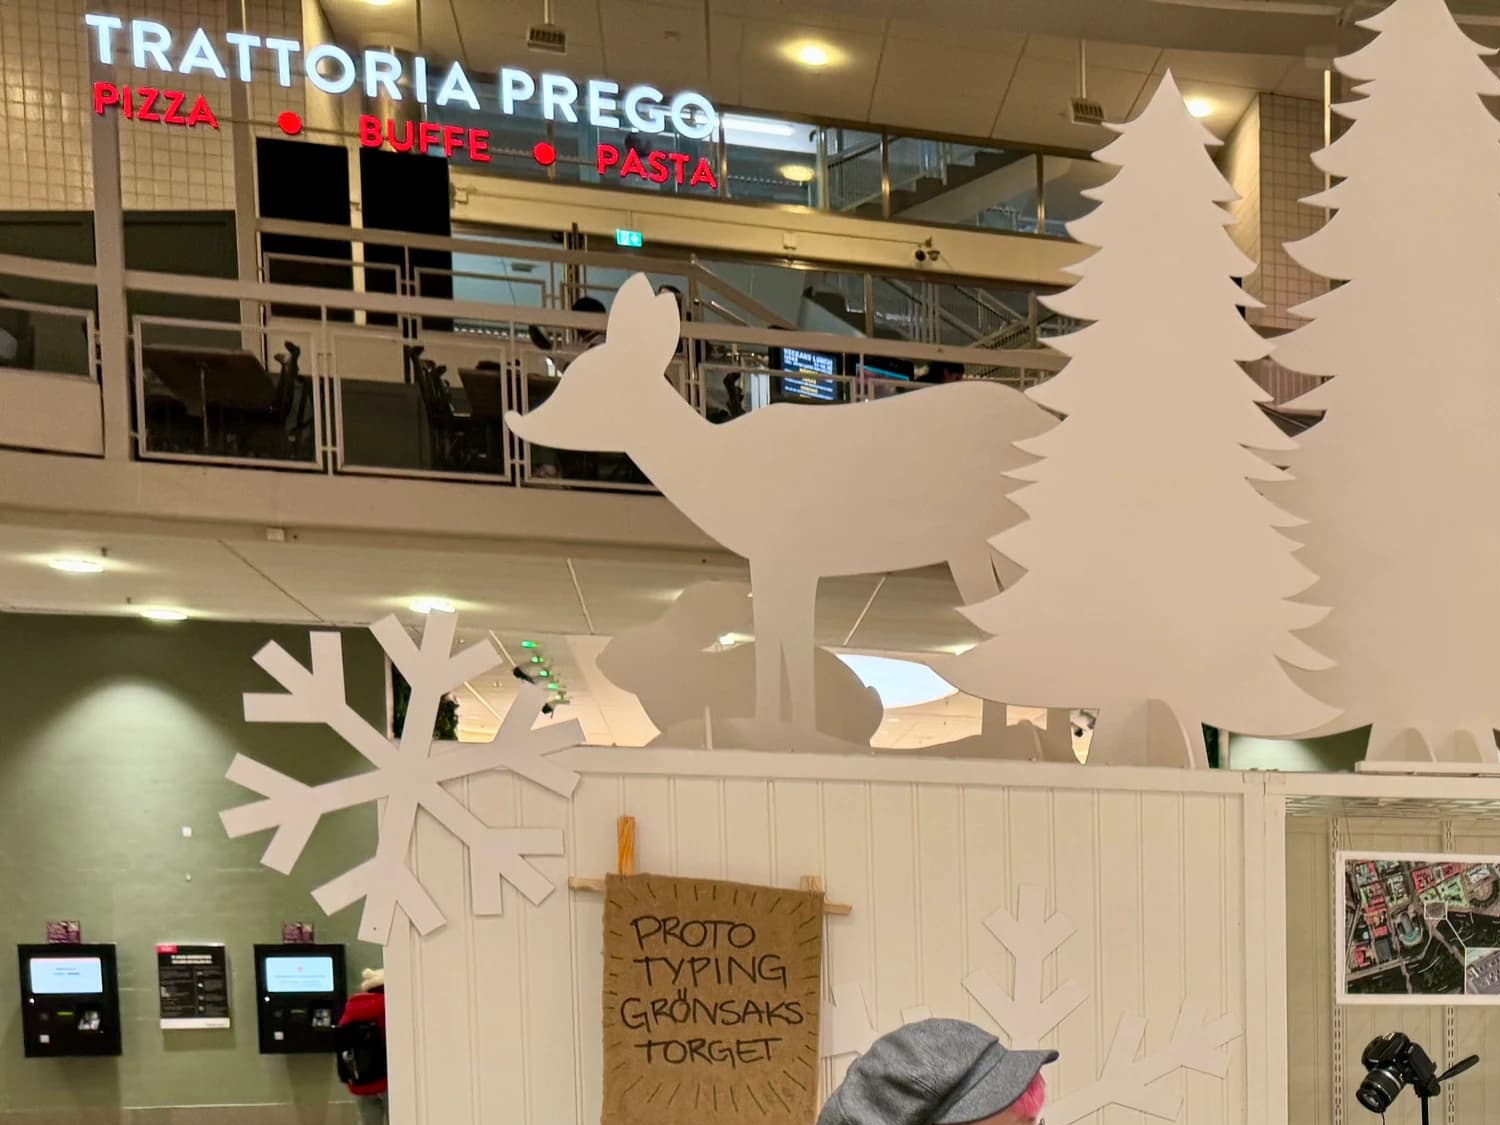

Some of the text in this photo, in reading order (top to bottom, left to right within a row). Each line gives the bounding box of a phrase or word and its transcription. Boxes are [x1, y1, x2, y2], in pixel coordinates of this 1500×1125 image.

[85, 13, 716, 140] TRATTORIA PREGO
[93, 81, 719, 190] PIZZA BUFFE PASTA
[630, 915, 756, 950] PROTO
[632, 954, 788, 990] TYPING
[619, 987, 805, 1034] GRÖNSAKS
[634, 1037, 784, 1070] TORGET
